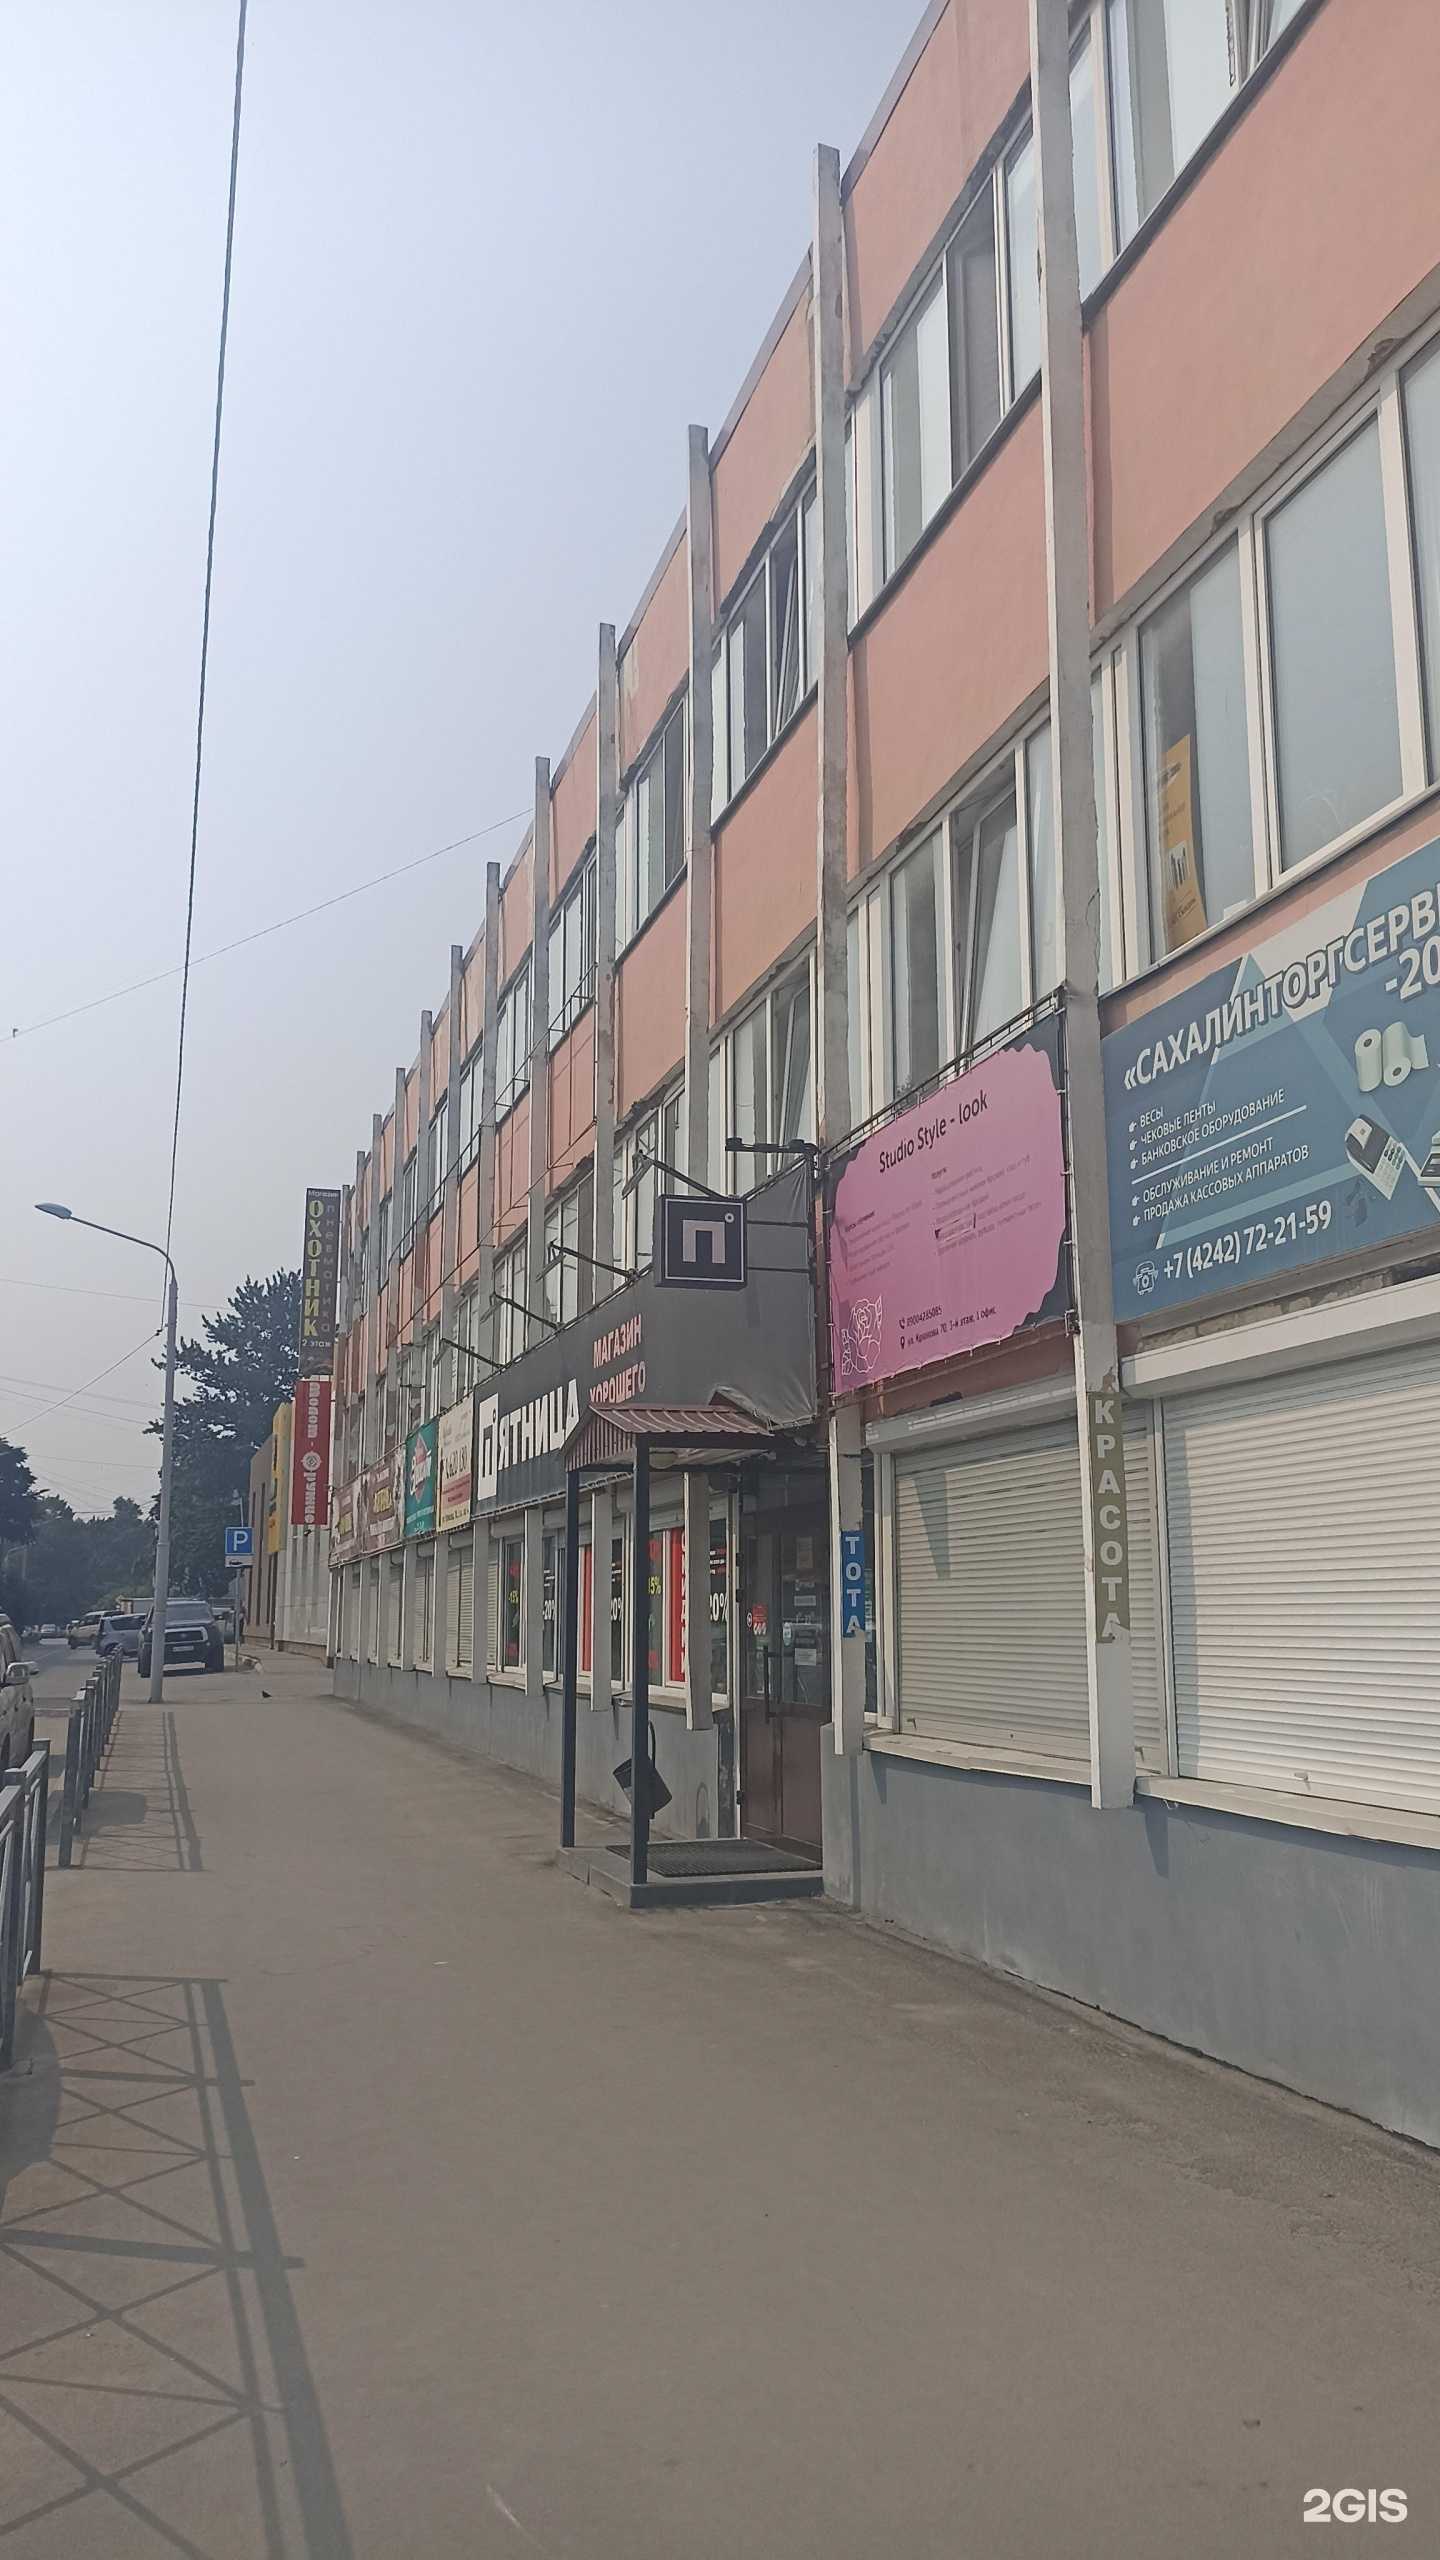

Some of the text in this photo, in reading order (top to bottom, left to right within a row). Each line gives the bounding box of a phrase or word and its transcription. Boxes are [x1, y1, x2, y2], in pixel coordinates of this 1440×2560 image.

[1124, 883, 1440, 1090] «САХАЛИНТОРГСЕРВ
[879, 1139, 915, 1174] Studio
[917, 1120, 947, 1150] Style
[958, 1089, 988, 1125] look
[1140, 1106, 1164, 1128] ВЕСЫ
[1140, 1100, 1216, 1145] ЧЕКОВЫЕ ЛЕНТЫ
[1141, 1088, 1285, 1166] БАНКОВСКОЕ ОБОРУДОВАНИЕ
[1143, 1137, 1273, 1203] ОБСЛУЖИВАНИЕ И РЕМОНТ
[1143, 1144, 1309, 1222] ПРОДАЖА КАССОВЫХ АППАРАТОВ
[303, 1200, 324, 1337] ОХОТНИК
[1163, 1200, 1332, 1279] +7 (4242) 72-21-59
[593, 1313, 642, 1369] МАГАЗИН
[589, 1360, 646, 1403] ХОРОШЕГО
[478, 1378, 580, 1500] ПЯТНИЦА
[1094, 1399, 1123, 1638] КРАСОТА
